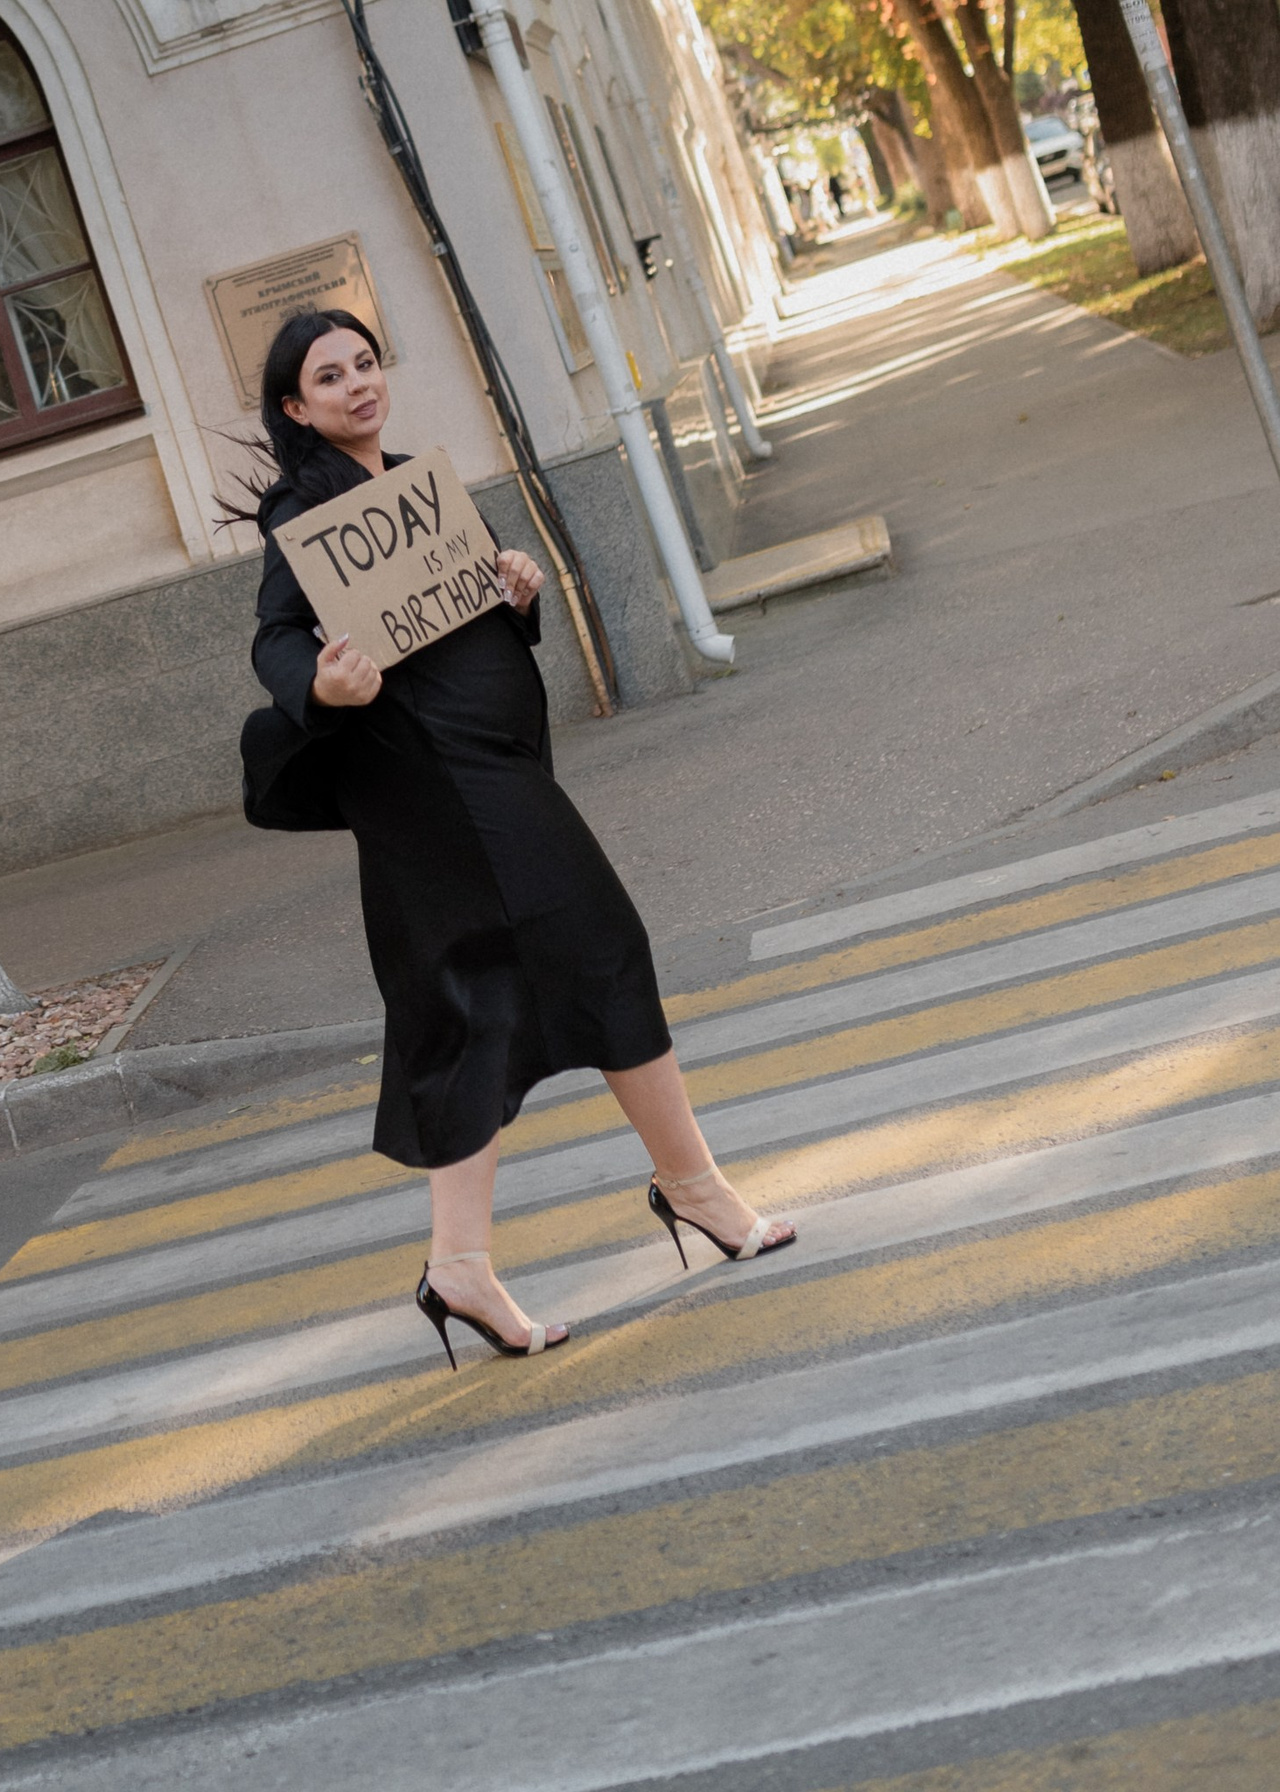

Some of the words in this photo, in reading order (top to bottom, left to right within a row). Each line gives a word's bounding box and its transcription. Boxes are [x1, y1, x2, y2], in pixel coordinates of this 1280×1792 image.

[240, 276, 347, 318] ЭТНОГРАФИЧЕСКИЙ
[258, 271, 321, 298] КРЫМСКИЙ
[301, 470, 440, 587] TODAY
[423, 550, 443, 575] IS
[445, 529, 470, 563] MY
